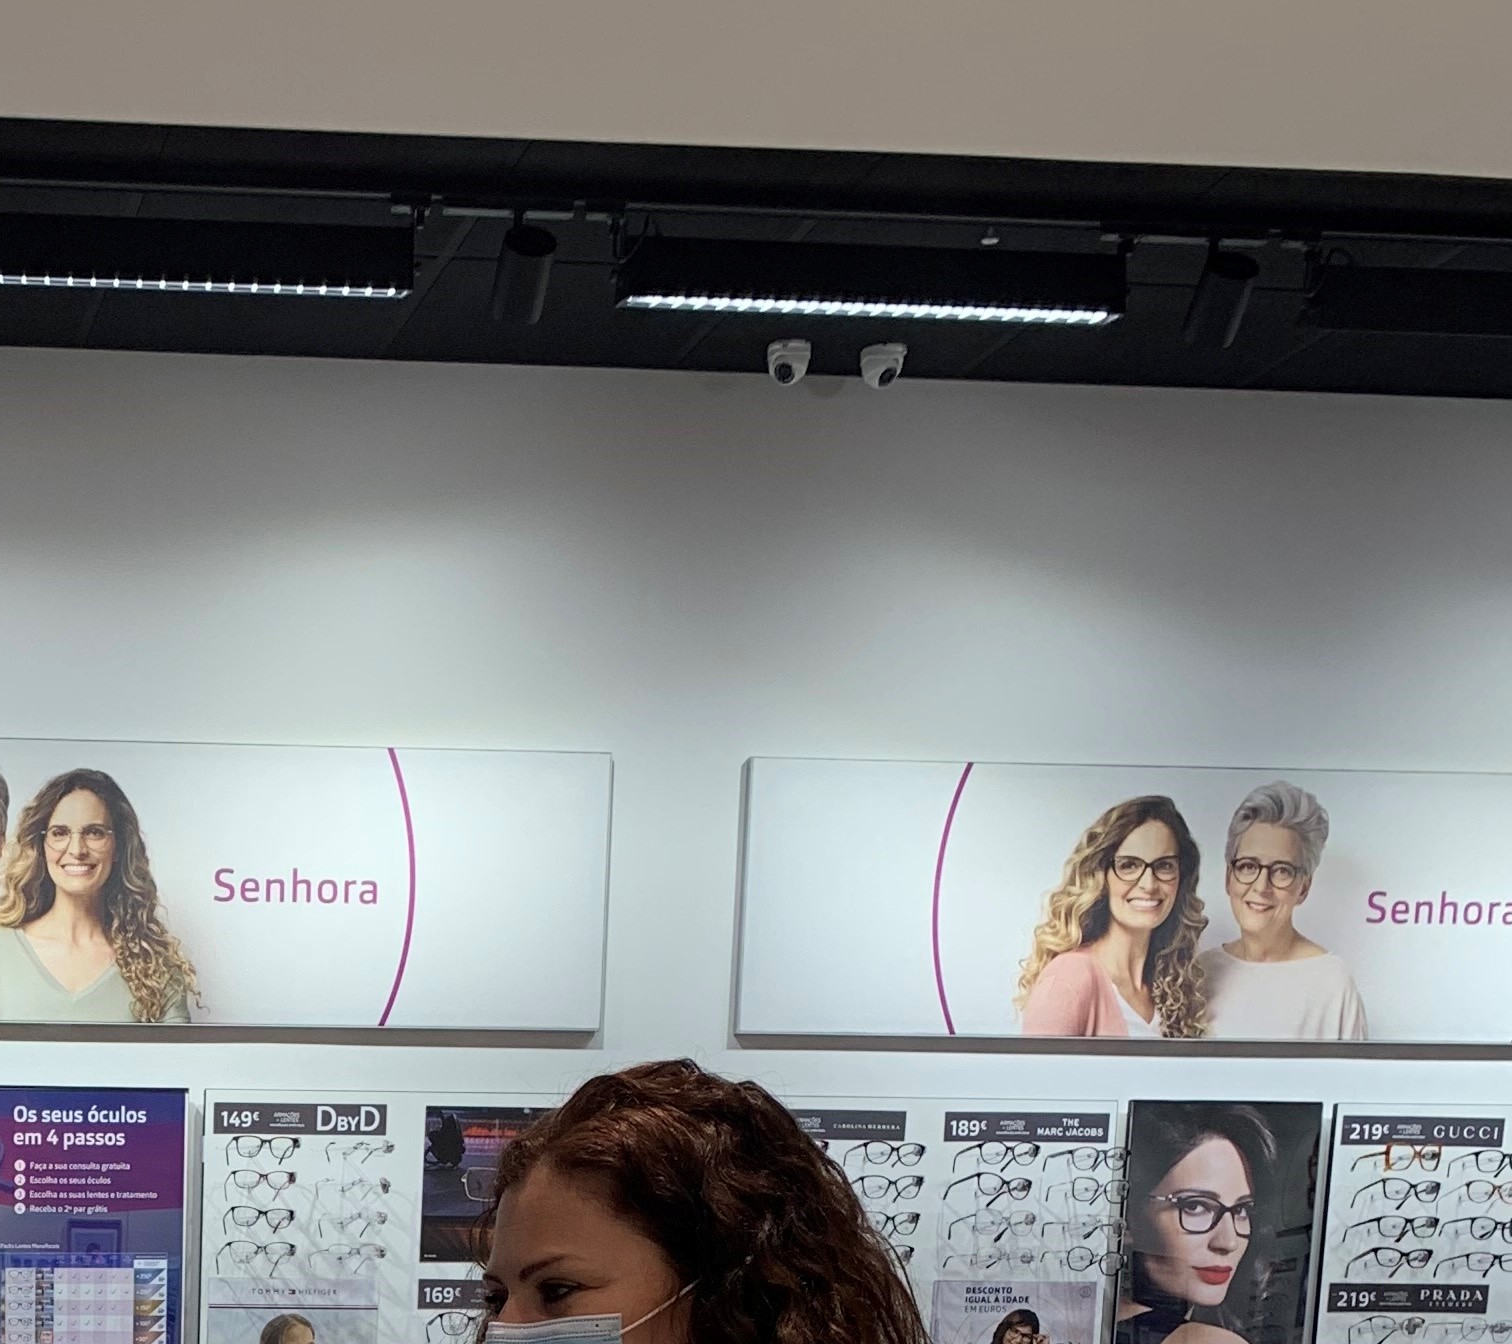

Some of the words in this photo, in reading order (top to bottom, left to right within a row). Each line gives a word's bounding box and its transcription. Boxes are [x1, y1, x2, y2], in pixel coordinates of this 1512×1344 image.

[213, 867, 379, 905] Senhora
[1366, 890, 1512, 925] Senhora
[13, 1105, 37, 1123] Os
[41, 1109, 83, 1123] seus
[88, 1104, 147, 1123] óculos
[221, 1111, 260, 1127] 149€
[950, 1120, 987, 1136] 189€
[1062, 1118, 1079, 1127] THE
[1037, 1127, 1063, 1136] MARC
[1065, 1128, 1103, 1137] JACOBS
[1350, 1123, 1390, 1140] 219€
[1433, 1126, 1498, 1139] GUCCI
[13, 1132, 41, 1145] em
[46, 1129, 59, 1145] 4
[63, 1131, 126, 1150] passos
[29, 1162, 47, 1172] Faça
[69, 1161, 100, 1170] consulta
[101, 1162, 131, 1172] gratuita
[29, 1176, 57, 1184] Escolha
[87, 1176, 111, 1185] óculos
[29, 1190, 57, 1199] Escolha
[87, 1190, 109, 1199] lentes
[116, 1190, 158, 1199] tratamento
[29, 1204, 56, 1213] Receba
[73, 1206, 86, 1215] par
[87, 1204, 108, 1214] grátis
[298, 1288, 337, 1296] HILFIGER
[424, 1287, 461, 1303] 169€
[966, 1286, 1013, 1294] DESCONTO
[1337, 1291, 1376, 1307] 219€
[1419, 1289, 1483, 1301] PRADA
